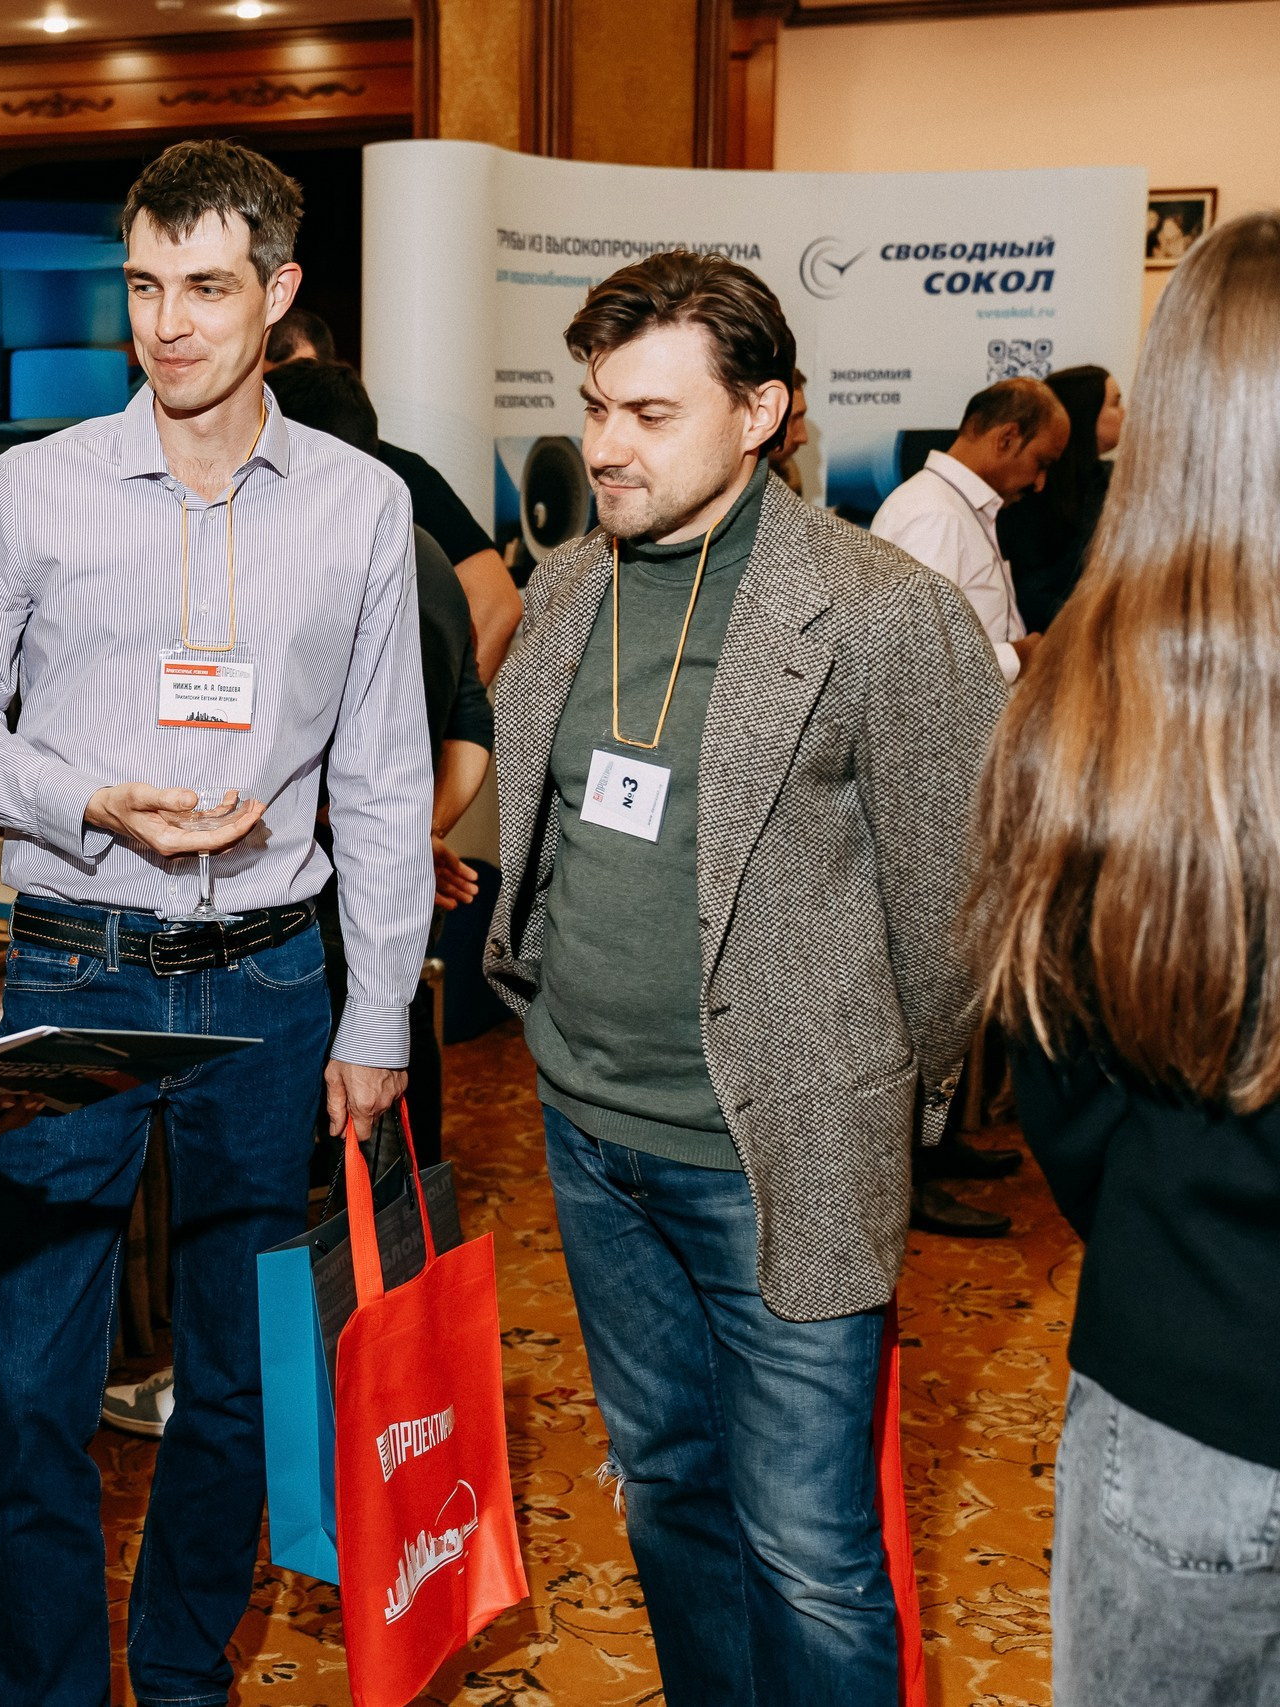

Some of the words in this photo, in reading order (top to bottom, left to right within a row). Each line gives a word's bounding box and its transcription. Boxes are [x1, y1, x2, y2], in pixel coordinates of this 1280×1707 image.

[880, 235, 1055, 262] СВОБОДНЫЙ
[923, 270, 1055, 295] СОКОЛ
[830, 368, 912, 382] ЭКОНОМИЯ
[828, 391, 901, 405] РЕСУРСОВ
[172, 682, 192, 691] НИИЖБ
